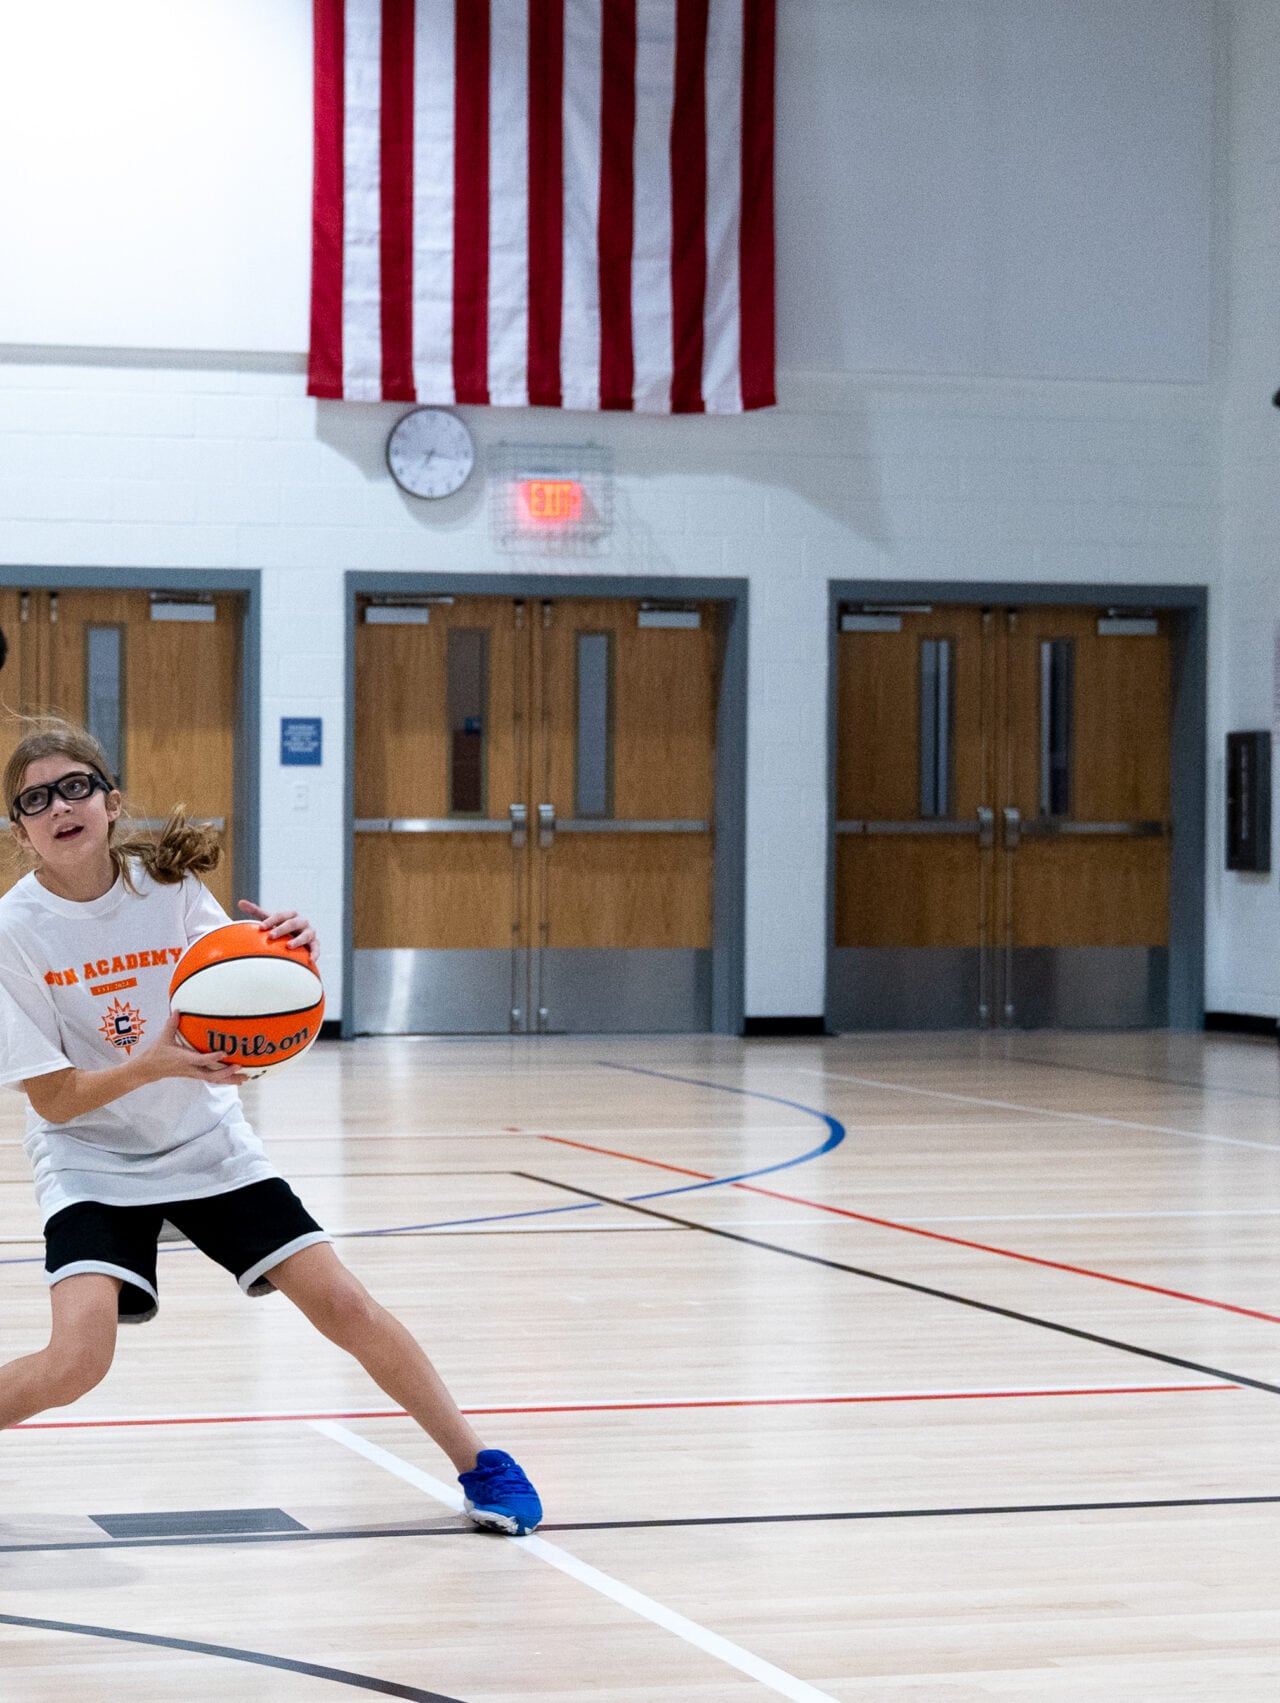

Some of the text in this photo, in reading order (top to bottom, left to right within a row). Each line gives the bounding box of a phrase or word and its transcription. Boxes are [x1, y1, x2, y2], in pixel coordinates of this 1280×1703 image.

[83, 948, 182, 980] ACADEMY
[114, 1015, 132, 1035] C
[207, 1026, 309, 1057] Wilson
